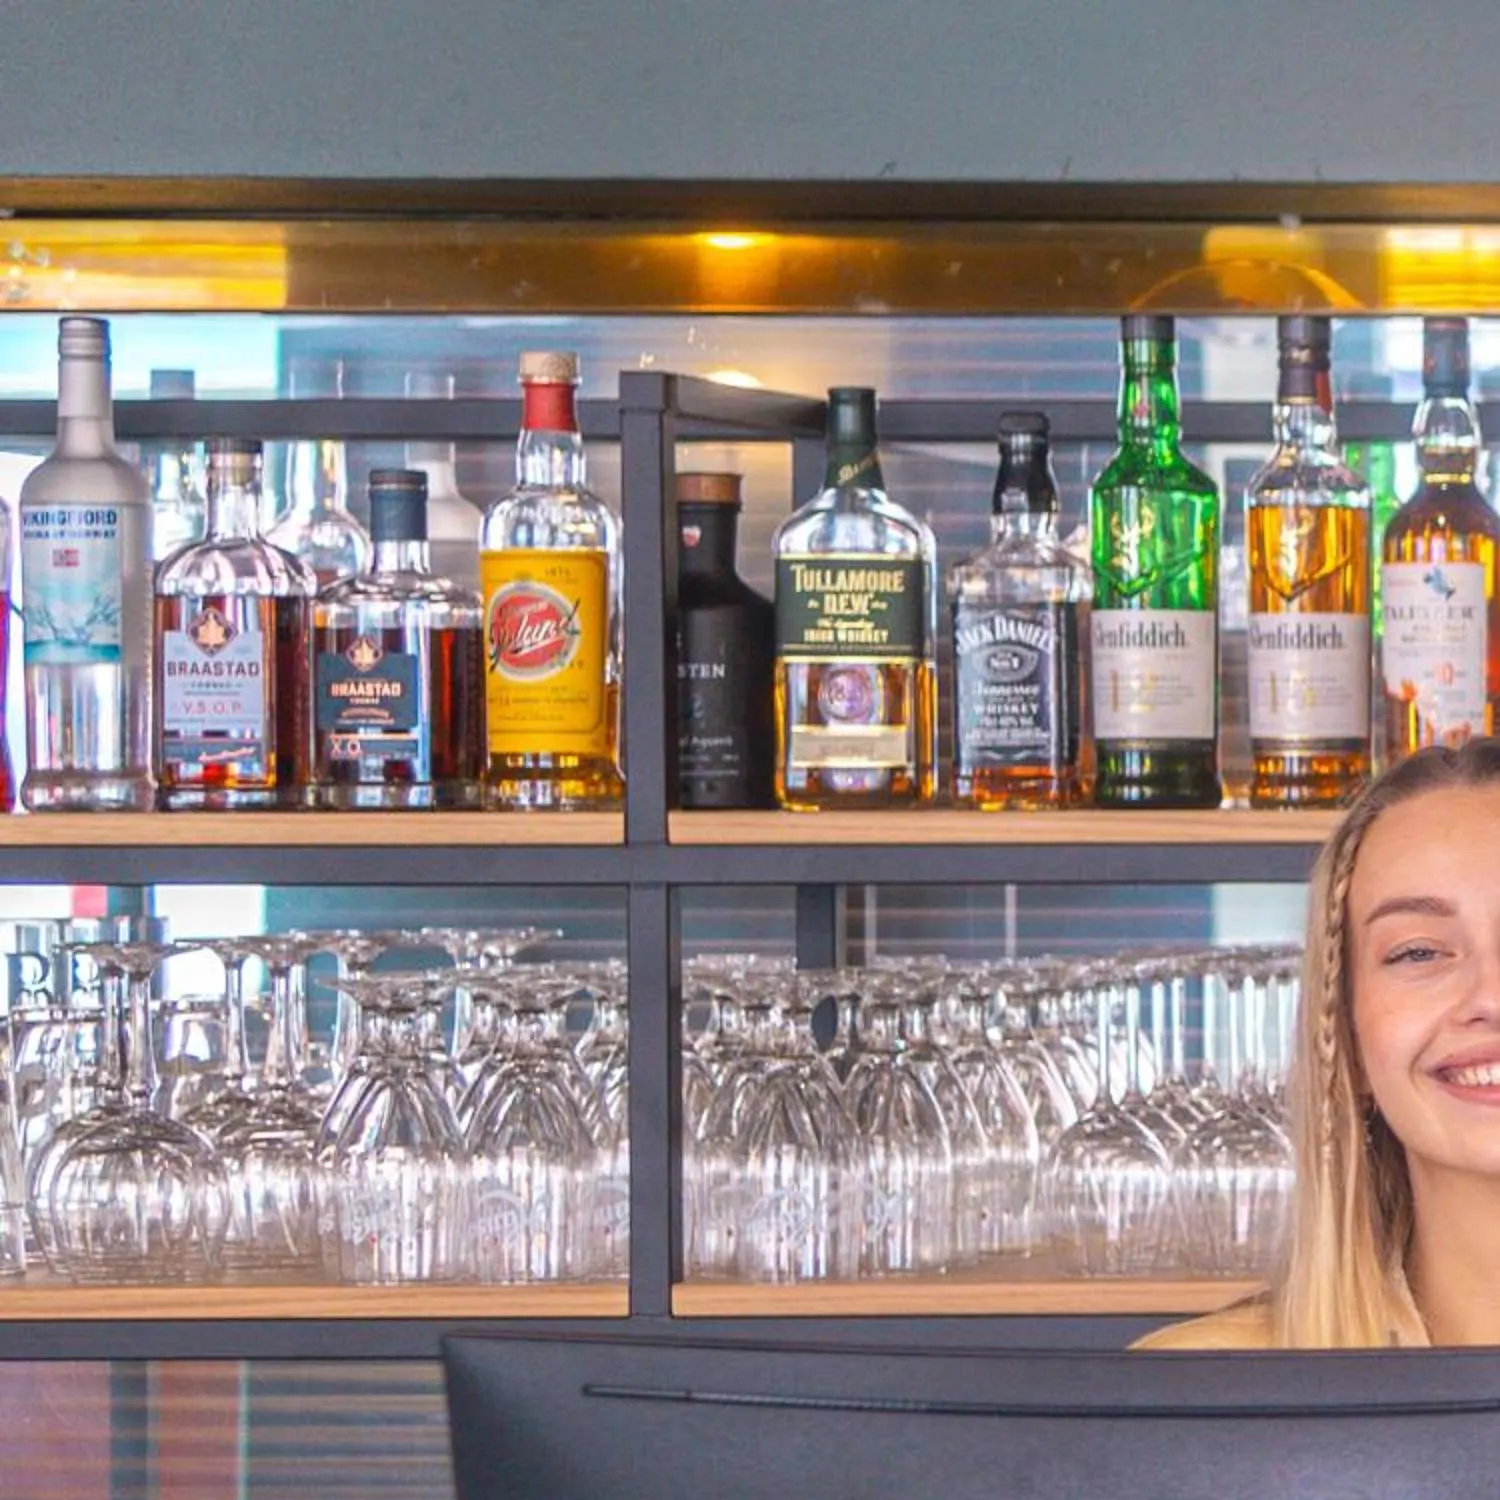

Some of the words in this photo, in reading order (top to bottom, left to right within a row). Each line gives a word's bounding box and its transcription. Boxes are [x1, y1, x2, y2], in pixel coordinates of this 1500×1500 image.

[790, 563, 905, 593] TULLAMORE
[1095, 620, 1186, 649] lenfiddich
[167, 661, 260, 677] BRAASTAD
[331, 682, 402, 697] BRAASTAD
